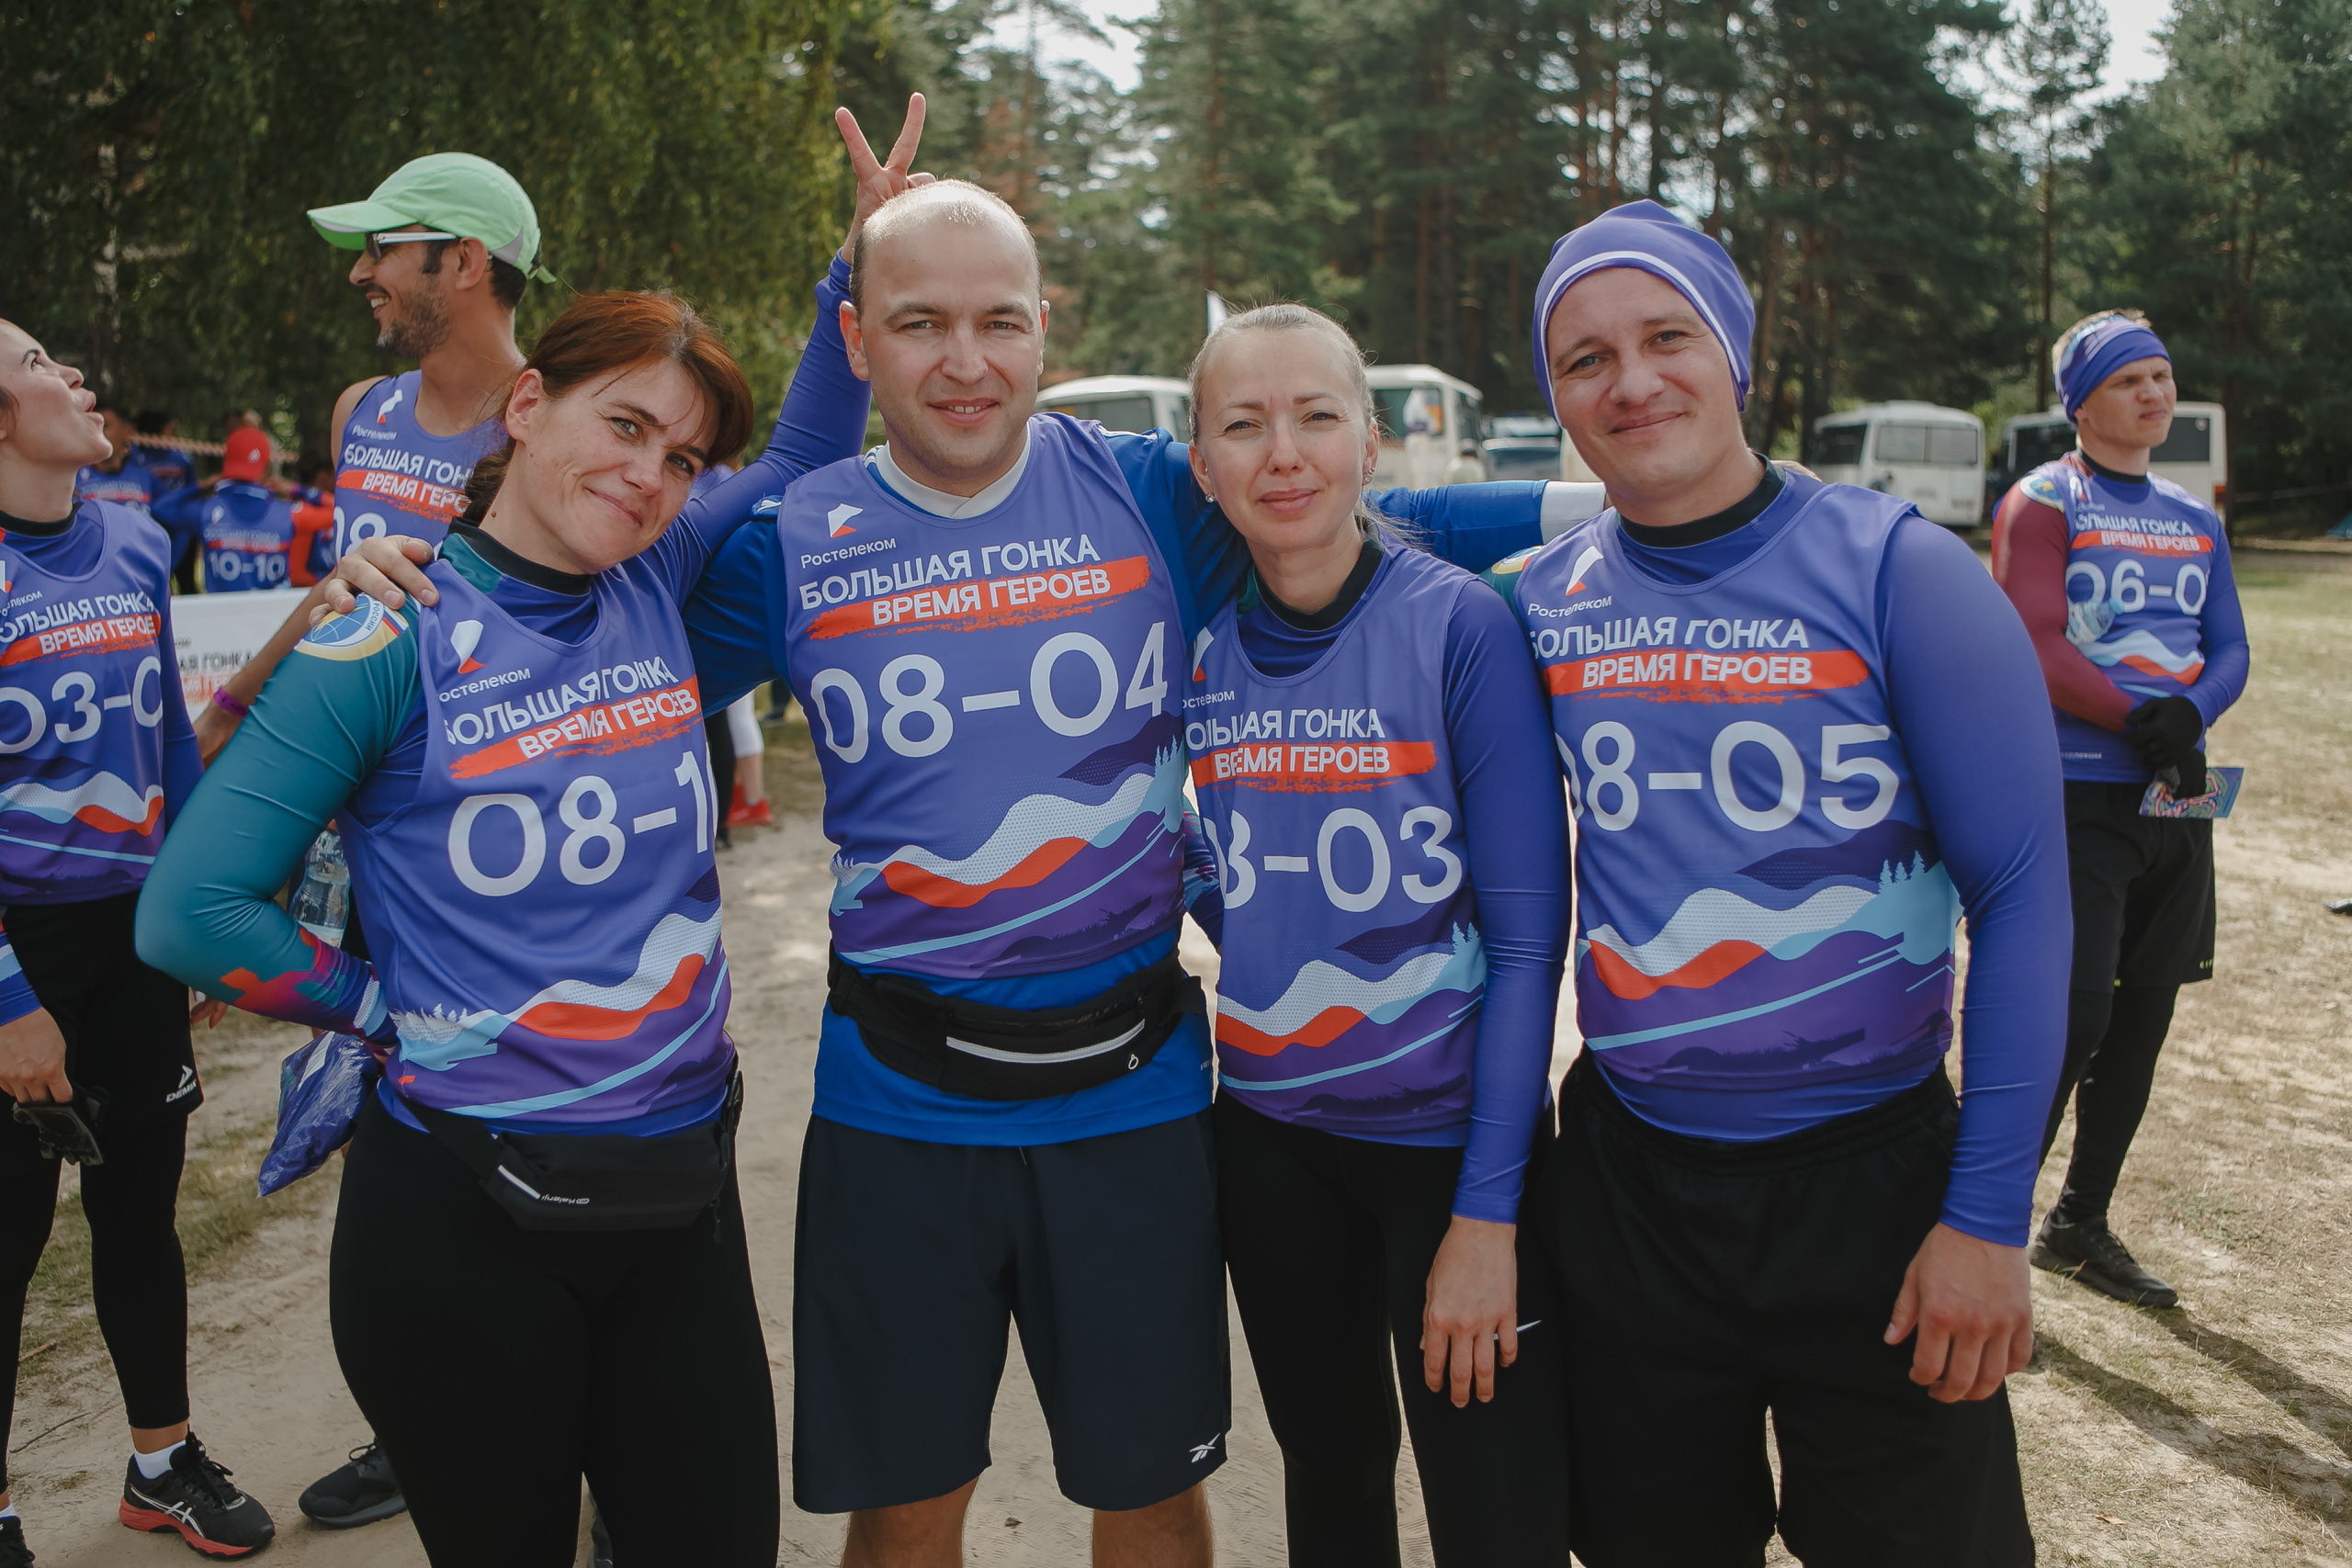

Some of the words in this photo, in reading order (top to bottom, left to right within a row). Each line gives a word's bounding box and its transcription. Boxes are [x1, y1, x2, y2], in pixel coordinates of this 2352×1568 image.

[344, 443, 425, 472] БОЛЬШАЯ
[424, 457, 475, 490] ГОН
[362, 472, 420, 501] ВРЕМЯ
[419, 484, 472, 514] ГЕРО
[2100, 530, 2147, 548] ВРЕМЯ
[2146, 535, 2200, 551] ГЕРОЕВ
[2140, 517, 2195, 536] ГОНКА
[798, 547, 973, 611] БОЛЬШАЯ
[981, 533, 1102, 575] ГОНКА
[800, 537, 897, 569] Ростелеком
[872, 586, 982, 626] ВРЕМЯ
[989, 569, 1112, 608] ГЕРОЕВ
[1527, 595, 1612, 618] Ростелеком
[2065, 558, 2211, 616] 06-0
[0, 598, 96, 643] ОЛЬШАЯ
[39, 620, 107, 655] ВРЕМЯ
[107, 615, 156, 638] ГЕРОЕ
[365, 603, 380, 632] РОССИИ
[1683, 618, 1810, 649] ГОНКА
[438, 668, 531, 703] остелеком
[600, 656, 680, 700] ГОНКА
[1582, 653, 1676, 688] ВРЕМЯ
[1683, 653, 1813, 685] ГЕРОЕВ
[0, 655, 164, 754] 03-0
[809, 620, 1168, 763] 08-04
[517, 710, 614, 759] ВРЕМЯ
[612, 688, 698, 731] ГЕРОЕВ
[1288, 708, 1386, 739] ГОНКА
[1214, 746, 1283, 779] ВРЕМЯ
[1289, 746, 1390, 773] ГЕРОЕВ
[447, 742, 718, 897] 08-1
